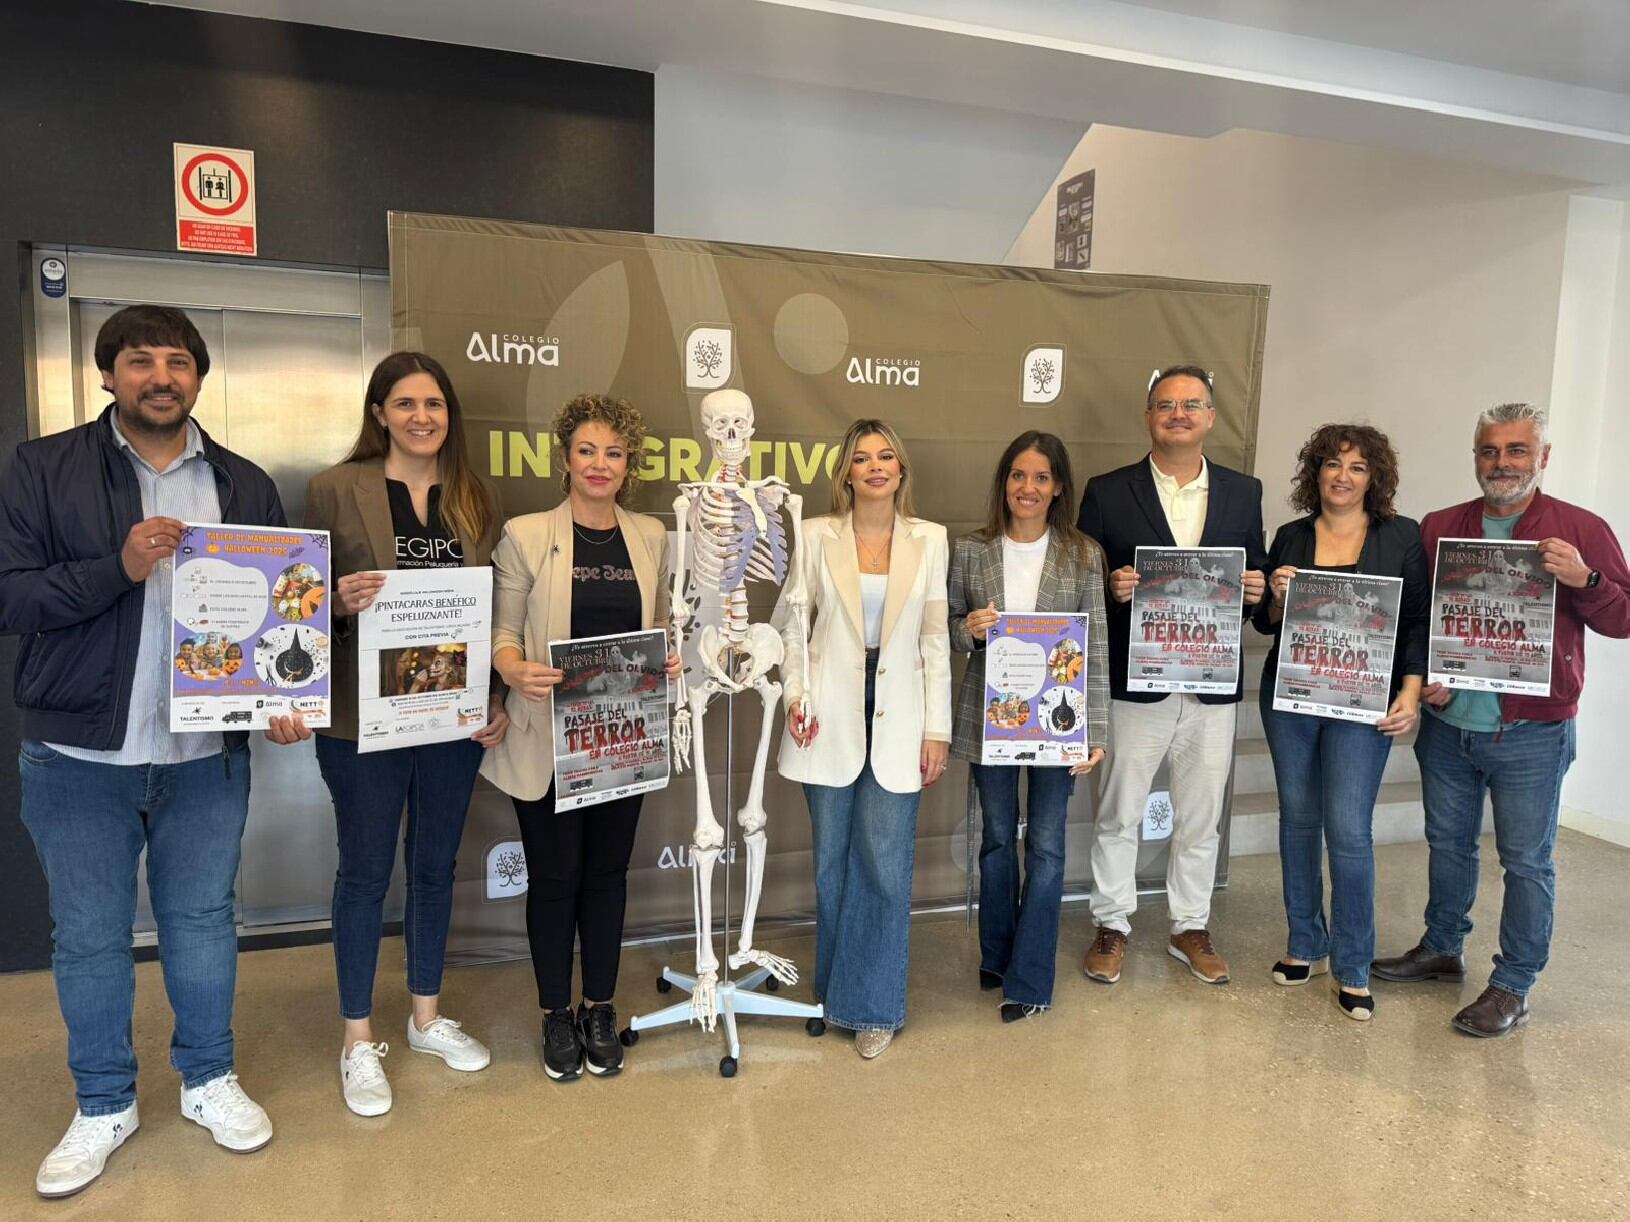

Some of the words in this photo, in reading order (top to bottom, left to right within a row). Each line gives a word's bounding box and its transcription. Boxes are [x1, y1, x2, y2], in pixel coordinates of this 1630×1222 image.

[504, 334, 560, 345] COLEGIO
[466, 332, 560, 366] Alma
[876, 358, 921, 366] COLEGIO
[846, 357, 920, 386] Alma
[489, 430, 840, 485] INGRTIV
[434, 594, 477, 608] BENÉFICO
[391, 609, 462, 622] ESPELUZNANTE!
[1142, 611, 1178, 621] PASAJE
[1181, 612, 1200, 622] DEL
[1442, 604, 1480, 616] PASAJE
[1484, 606, 1505, 619] DEL
[1141, 622, 1218, 643] TERROR
[1441, 615, 1527, 642] TERROR
[1174, 644, 1209, 653] COLEGIO
[1212, 646, 1234, 654] ALMA
[1292, 632, 1329, 646] PASAJE
[1332, 638, 1351, 648] DEL
[1479, 640, 1516, 650] COLEGIO
[1522, 642, 1546, 654] ALMA
[1290, 642, 1369, 672] TERROR
[1324, 668, 1360, 680] COLEGIO
[1363, 673, 1384, 684] ALMA
[564, 711, 605, 728] PASAJE
[608, 708, 627, 721] DEL
[564, 717, 647, 753] TERROR
[590, 749, 602, 760] EN
[604, 742, 639, 758] COLEGIO
[642, 738, 664, 750] ALMA
[657, 845, 736, 869] Ala
